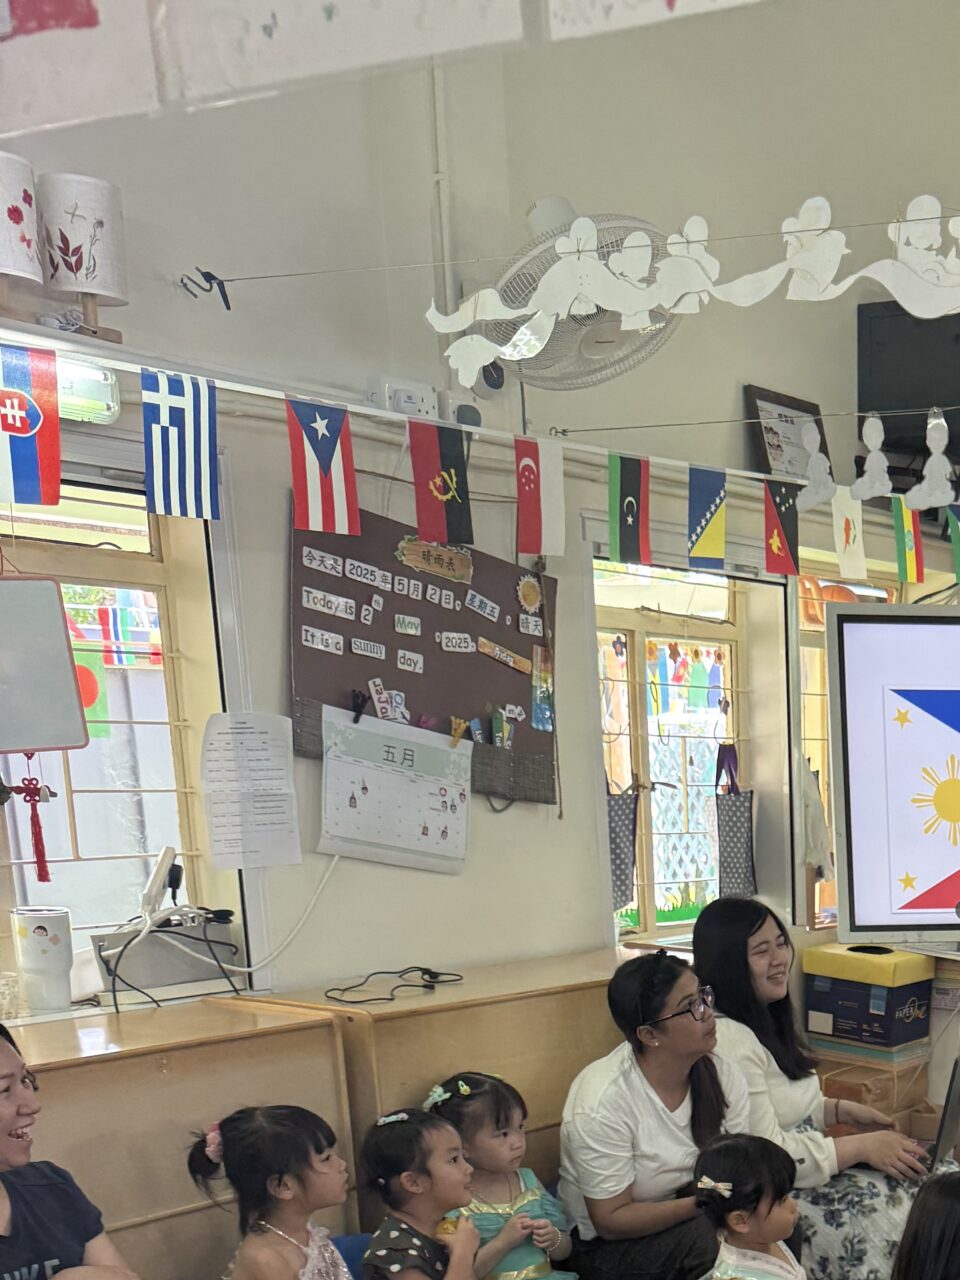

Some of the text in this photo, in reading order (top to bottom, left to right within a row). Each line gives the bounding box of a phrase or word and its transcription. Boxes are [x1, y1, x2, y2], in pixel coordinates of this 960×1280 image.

[304, 549, 341, 575] 今天是
[303, 588, 340, 616] Today
[344, 600, 354, 616] is
[363, 608, 372, 622] 2
[396, 615, 420, 632] May
[303, 628, 316, 645] It
[320, 633, 330, 649] is
[382, 744, 415, 768] 五月
